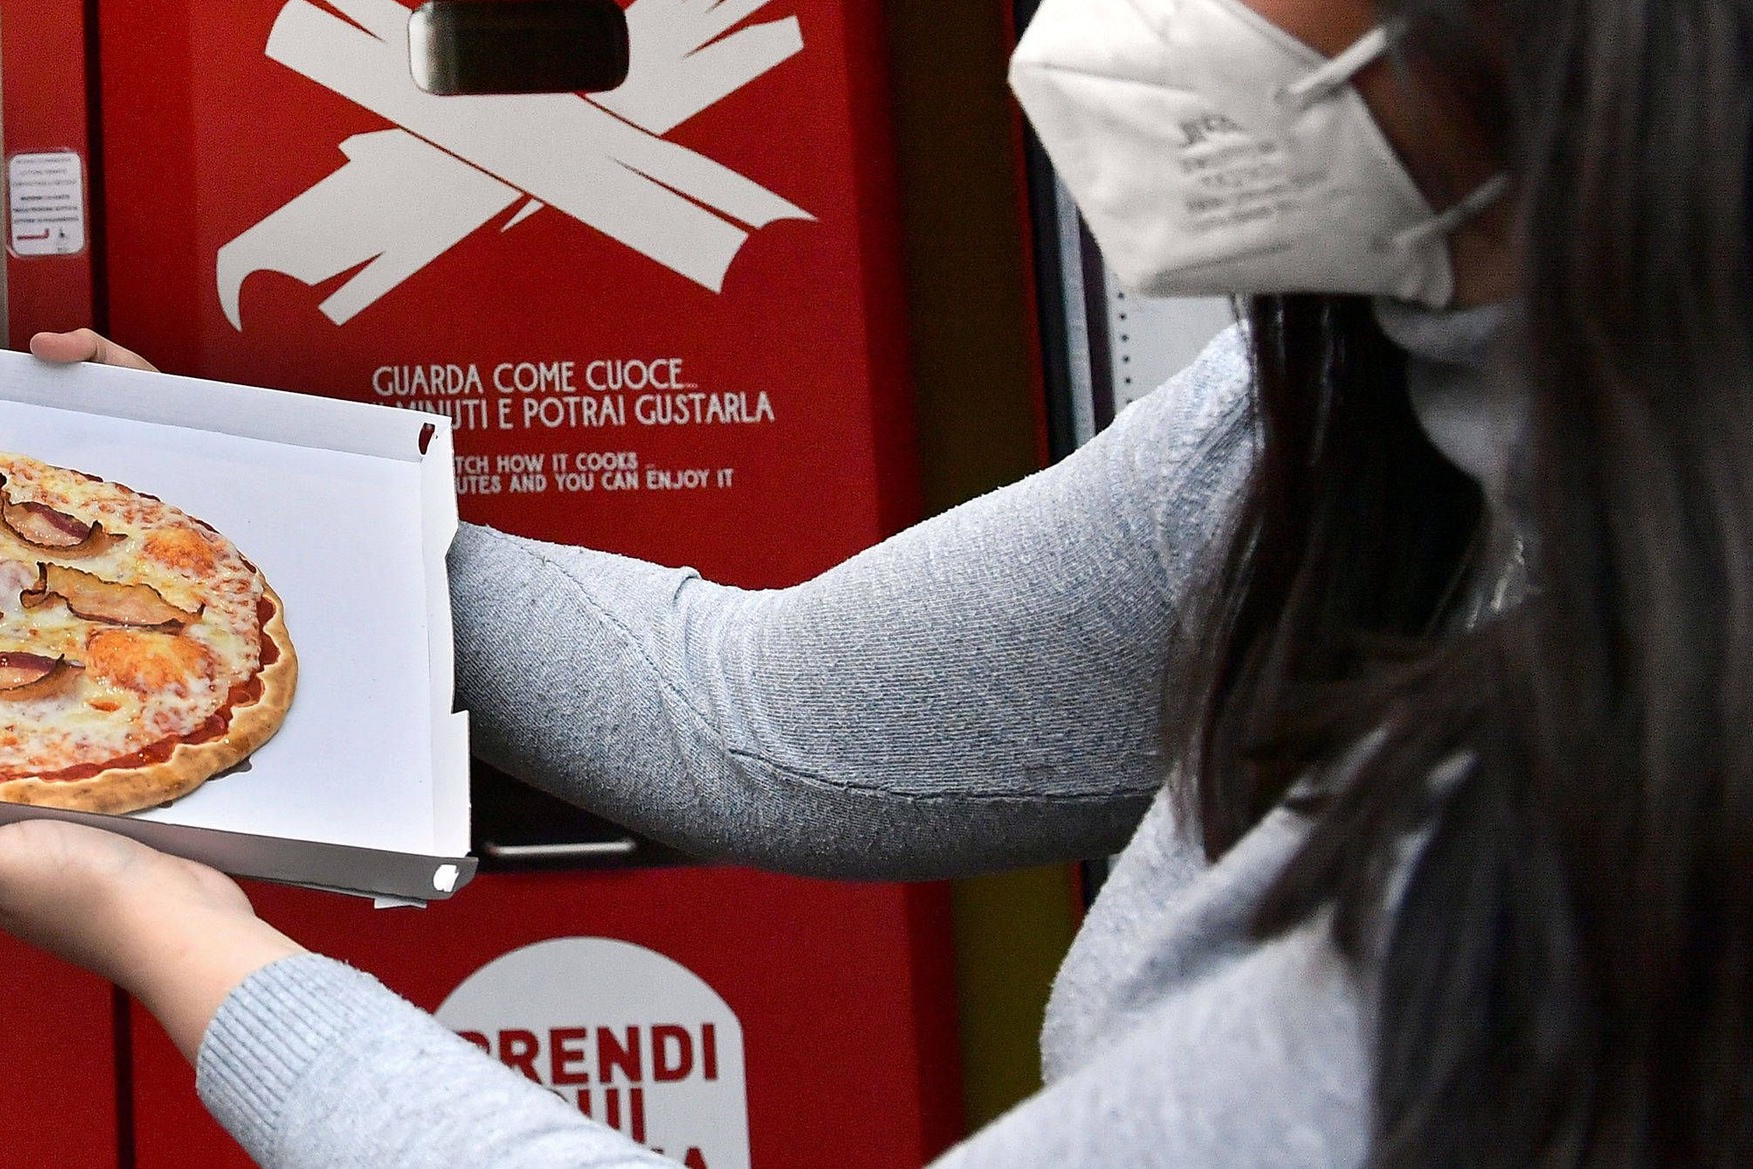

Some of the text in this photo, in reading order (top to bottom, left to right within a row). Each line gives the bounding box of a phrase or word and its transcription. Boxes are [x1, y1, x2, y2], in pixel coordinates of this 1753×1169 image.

[372, 363, 484, 396] GUARDA
[493, 360, 576, 393] COME
[498, 397, 514, 430] E
[523, 395, 626, 428] POTRAI
[634, 391, 775, 425] GUSTARLA
[455, 455, 490, 475] TCH
[496, 454, 545, 473] HOW
[552, 453, 568, 473] IT
[457, 468, 734, 495] UTES AND YOU CAN ENJOY IT
